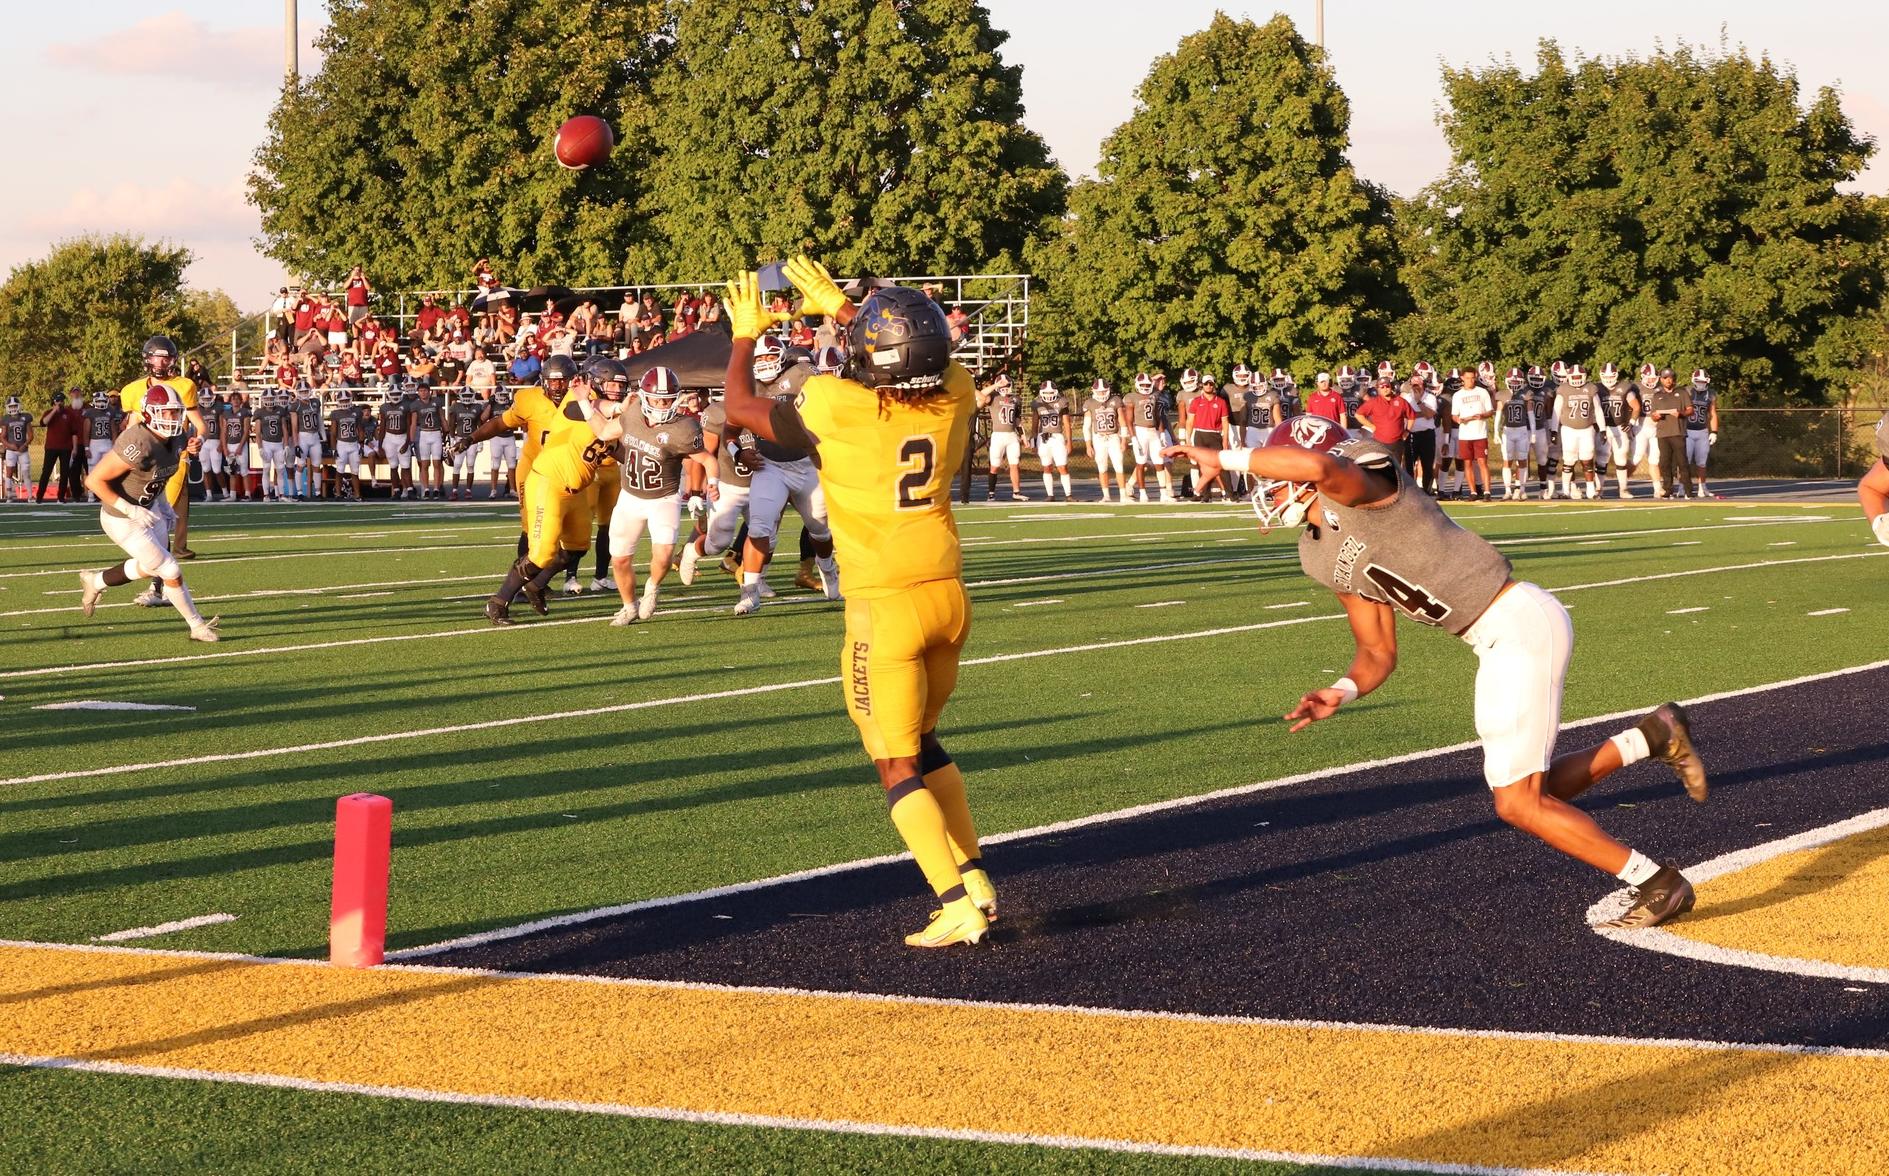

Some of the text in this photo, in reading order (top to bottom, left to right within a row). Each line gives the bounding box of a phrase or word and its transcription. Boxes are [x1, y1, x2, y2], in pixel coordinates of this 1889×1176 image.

[998, 406, 1014, 425] 40
[1143, 402, 1154, 421] 2
[1251, 407, 1270, 425] 92
[1507, 404, 1523, 423] 13
[1568, 400, 1590, 419] 79
[1601, 399, 1623, 418] 77
[269, 419, 278, 436] 5
[424, 411, 434, 428] 4
[462, 417, 472, 434] 2
[1095, 413, 1116, 431] 23
[14, 425, 22, 442] 6
[340, 422, 356, 439] 24
[123, 443, 141, 462] 91
[625, 448, 664, 491] 42
[895, 433, 937, 512] 2
[852, 641, 871, 717] JACKETS
